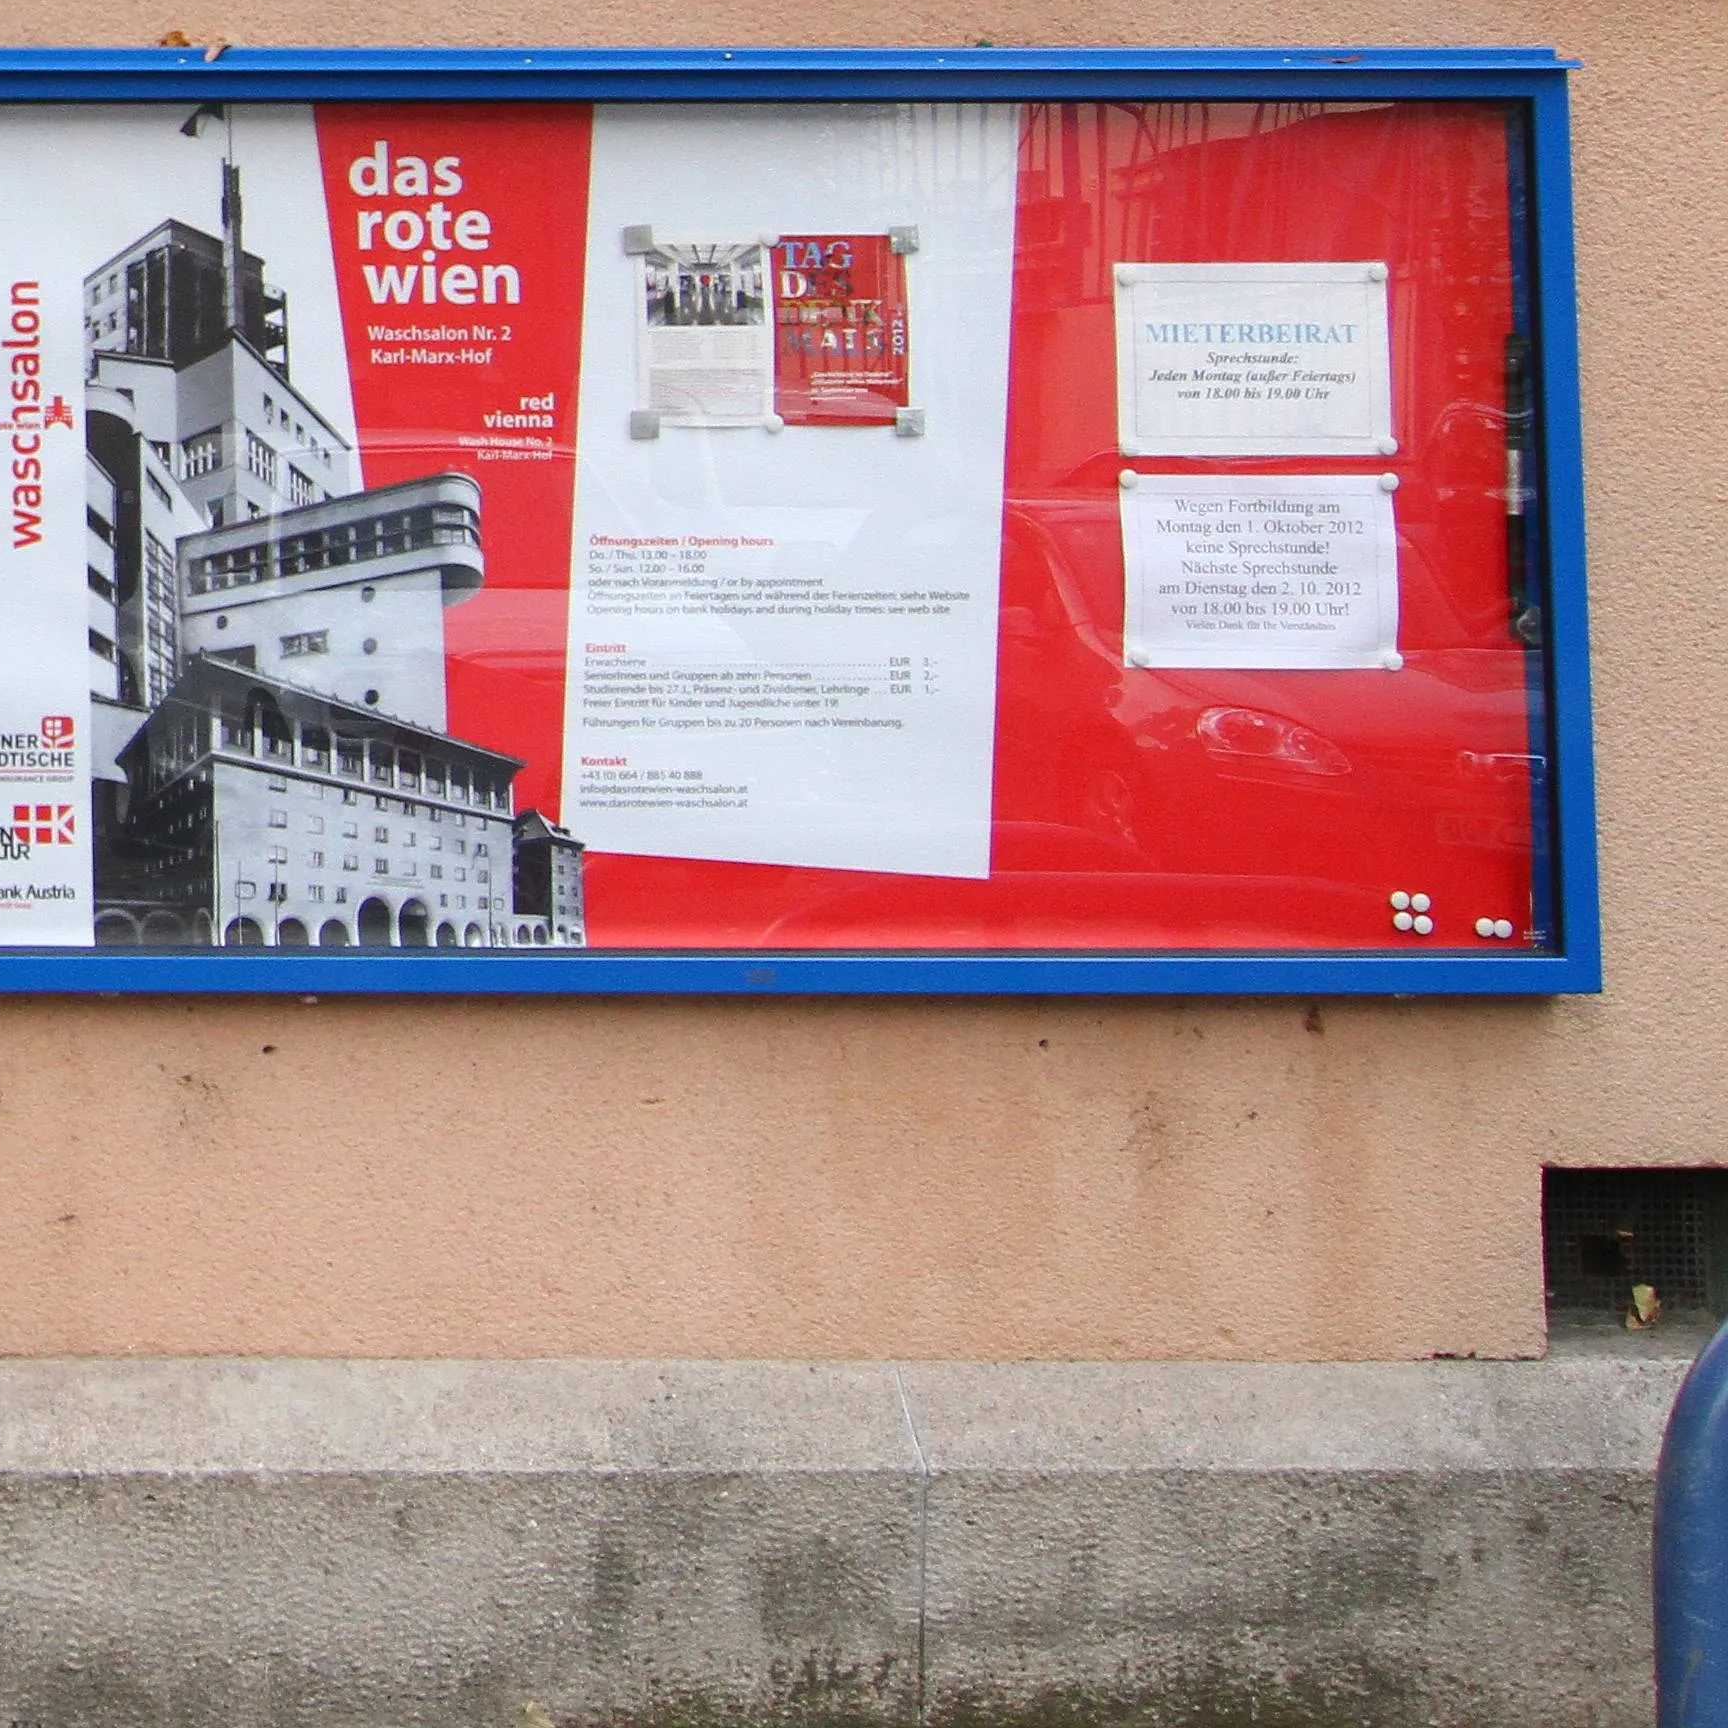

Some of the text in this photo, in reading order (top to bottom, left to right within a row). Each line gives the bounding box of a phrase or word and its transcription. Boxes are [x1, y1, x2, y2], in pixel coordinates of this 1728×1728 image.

[348, 140, 464, 197] das
[357, 202, 493, 251] rote
[780, 241, 854, 270] TAG
[362, 250, 521, 304] wien
[367, 325, 512, 341] Waschsalon Nr. 2
[1145, 323, 1358, 343] MIETERBEIRAT
[371, 348, 493, 364] Karl-Marx-Hof
[1206, 352, 1299, 364] Sprechstunde:
[1149, 370, 1356, 384] Jeden Montag (außer Feiertags)
[1178, 388, 1330, 400] von 18.00 bis 19.00 Uhr
[520, 392, 554, 410] red
[1, 280, 43, 550] waschsalon
[483, 410, 553, 428] vienna
[458, 436, 489, 446] Wash
[490, 436, 524, 447] House
[477, 450, 552, 460] Karl-Marx-Hof
[1174, 500, 1340, 516] Wegen Fortbildung am
[1156, 520, 1364, 536] Montag den 1. Oktober 2012
[589, 534, 774, 548] Öffnungszeiten Opening hours
[1186, 540, 1330, 557] keine Sprechstunde!
[589, 551, 606, 560] Do.
[641, 551, 668, 560] 13.00
[679, 551, 706, 560] 18.00
[588, 564, 605, 573] So.
[639, 564, 665, 573] 12.00
[678, 564, 704, 573] 16.00
[1181, 560, 1338, 578] Nächste Sprechstunde
[588, 578, 612, 587] oder
[615, 578, 640, 587] nach
[642, 578, 718, 588] Voranmeldung
[740, 578, 752, 588] by
[756, 578, 823, 588] appointment
[588, 590, 666, 602] Öffnungszeiten
[685, 592, 739, 602] Feiertagen
[742, 592, 762, 600] und
[765, 591, 809, 601] während
[813, 591, 829, 601] der
[900, 591, 926, 601] siehe
[929, 591, 970, 601] Website
[1158, 582, 1362, 598] am Dienstag den 2. 10. 2012
[588, 605, 632, 615] Opening
[634, 605, 663, 614] hours
[682, 605, 706, 614] bank
[710, 605, 752, 616] holidays
[756, 605, 775, 614] and
[777, 605, 811, 616] during
[814, 605, 852, 616] holiday
[908, 605, 930, 614] web
[932, 606, 950, 614] site
[1171, 602, 1349, 616] von 18.00 bis 19.00 Uhr!
[1185, 620, 1216, 630] Vielen
[1218, 620, 1243, 630] Dank
[1247, 620, 1260, 630] für
[1263, 620, 1278, 630] Ihr
[586, 643, 626, 653] Eintritt
[584, 657, 910, 667] Erwachsene EUR
[649, 672, 669, 680] und
[672, 672, 717, 682] Gruppen
[720, 672, 734, 680] ab
[736, 672, 761, 680] zehn
[764, 672, 811, 681] Personen
[890, 671, 911, 680] EUR
[583, 685, 645, 694] Studierende
[649, 685, 663, 694] bis
[739, 685, 759, 694] und
[821, 685, 869, 696] Lehrlinge
[890, 684, 911, 694] EUR
[583, 698, 820, 709] Freier Eintritt für Kinder und Jugendliche unter
[583, 717, 639, 728] Führungen
[642, 718, 656, 727] für
[659, 718, 704, 729] Gruppen
[707, 718, 721, 727] bis
[740, 719, 751, 727] 20
[754, 718, 801, 727] Personen
[805, 718, 828, 727] nach
[831, 718, 904, 729] Vereinbarung.
[581, 756, 627, 766] Kontakt
[581, 771, 600, 781] +43
[618, 771, 638, 781] 664
[668, 771, 681, 781] 40
[580, 784, 748, 795] info@dasrotewien-waschsalon.at
[579, 799, 748, 808] www.dasrotewien-waschsalon.at
[26, 885, 75, 900] Austria
